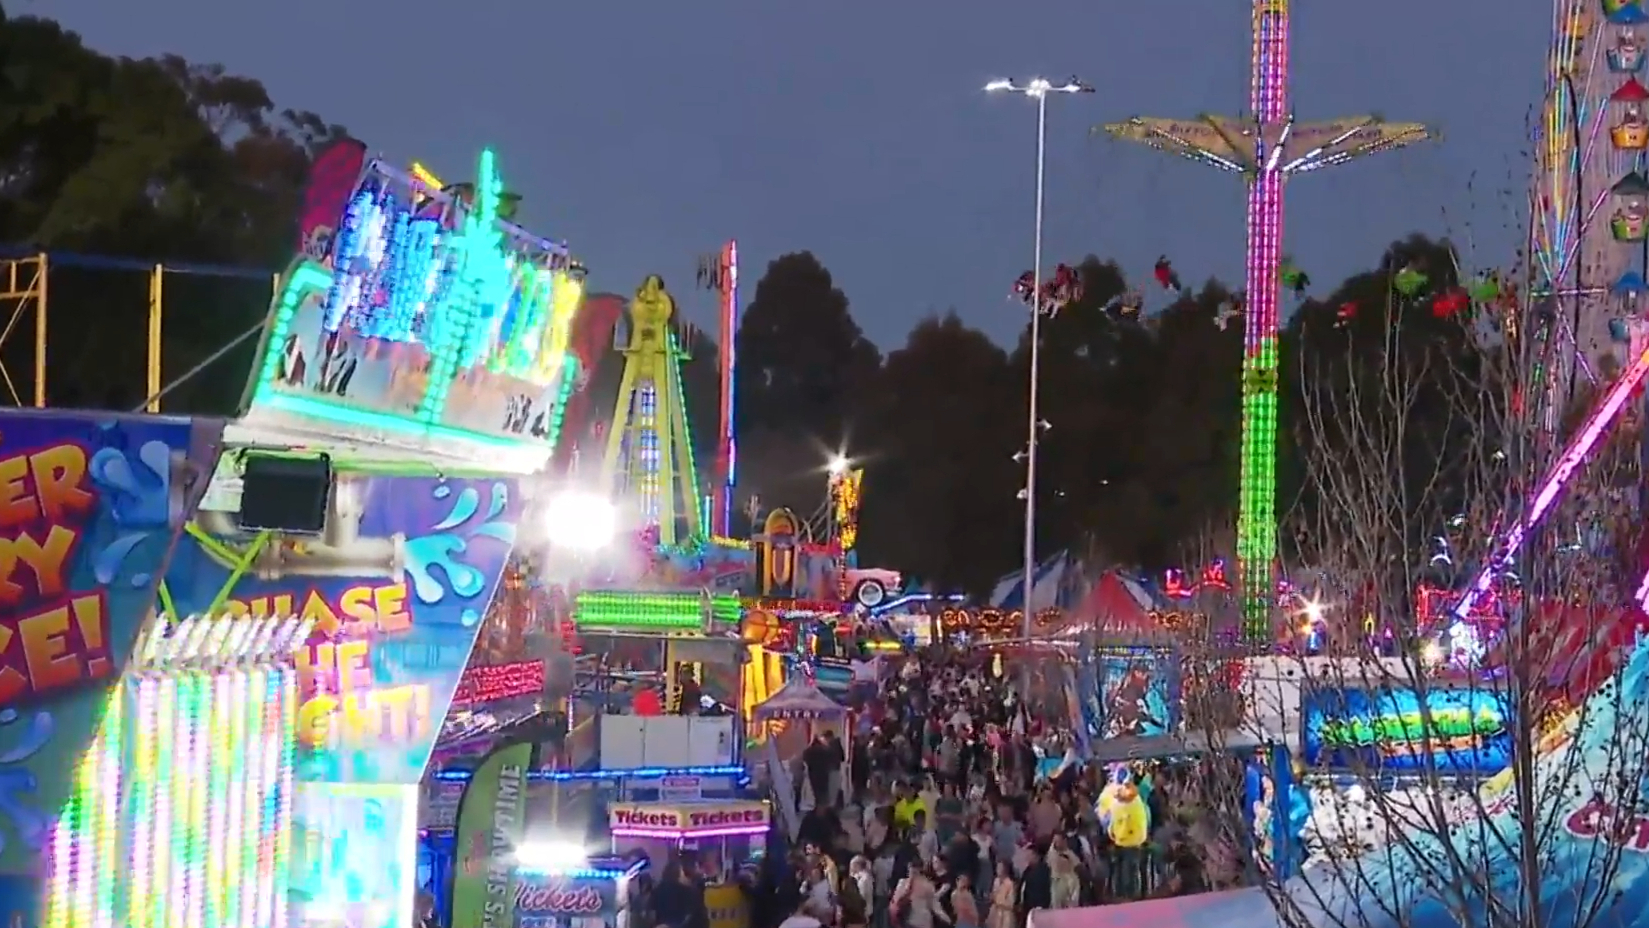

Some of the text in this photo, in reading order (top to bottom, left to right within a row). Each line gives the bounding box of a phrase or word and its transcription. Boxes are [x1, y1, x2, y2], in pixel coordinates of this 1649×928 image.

[773, 709, 821, 718] ENTRY
[615, 809, 764, 827] Tickets Tickets
[514, 882, 602, 912] Tickets
